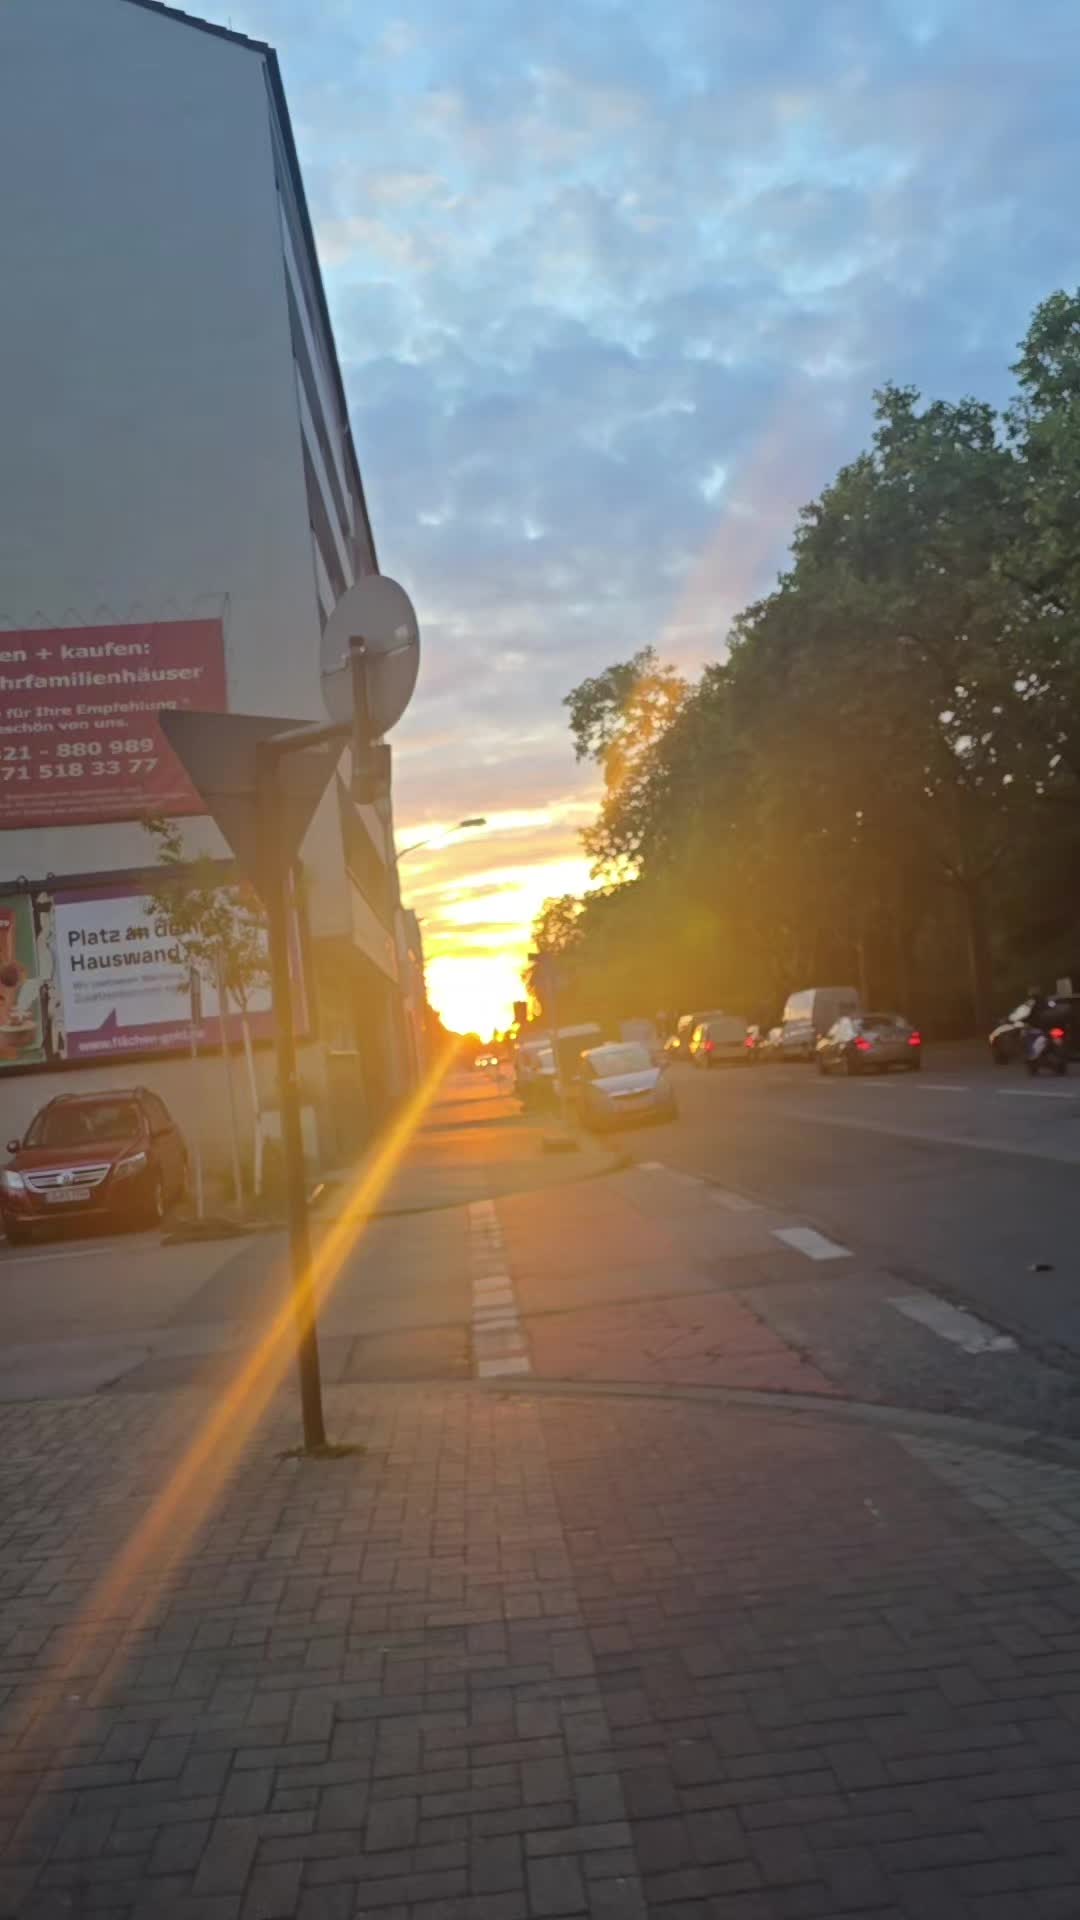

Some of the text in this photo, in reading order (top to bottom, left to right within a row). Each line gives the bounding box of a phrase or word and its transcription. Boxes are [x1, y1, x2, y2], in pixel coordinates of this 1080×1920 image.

[35, 647, 53, 661] +
[60, 641, 151, 661] kaufen:
[6, 705, 32, 719] für
[35, 703, 72, 718] Ihre
[58, 719, 89, 732] von
[93, 717, 128, 730] uns.
[0, 744, 32, 761] 21
[56, 740, 103, 758] 880
[109, 737, 154, 755] 989
[39, 762, 84, 780] 518
[90, 759, 120, 777] 33
[128, 757, 159, 774] 77
[68, 927, 120, 949] Platz
[125, 924, 150, 941] an
